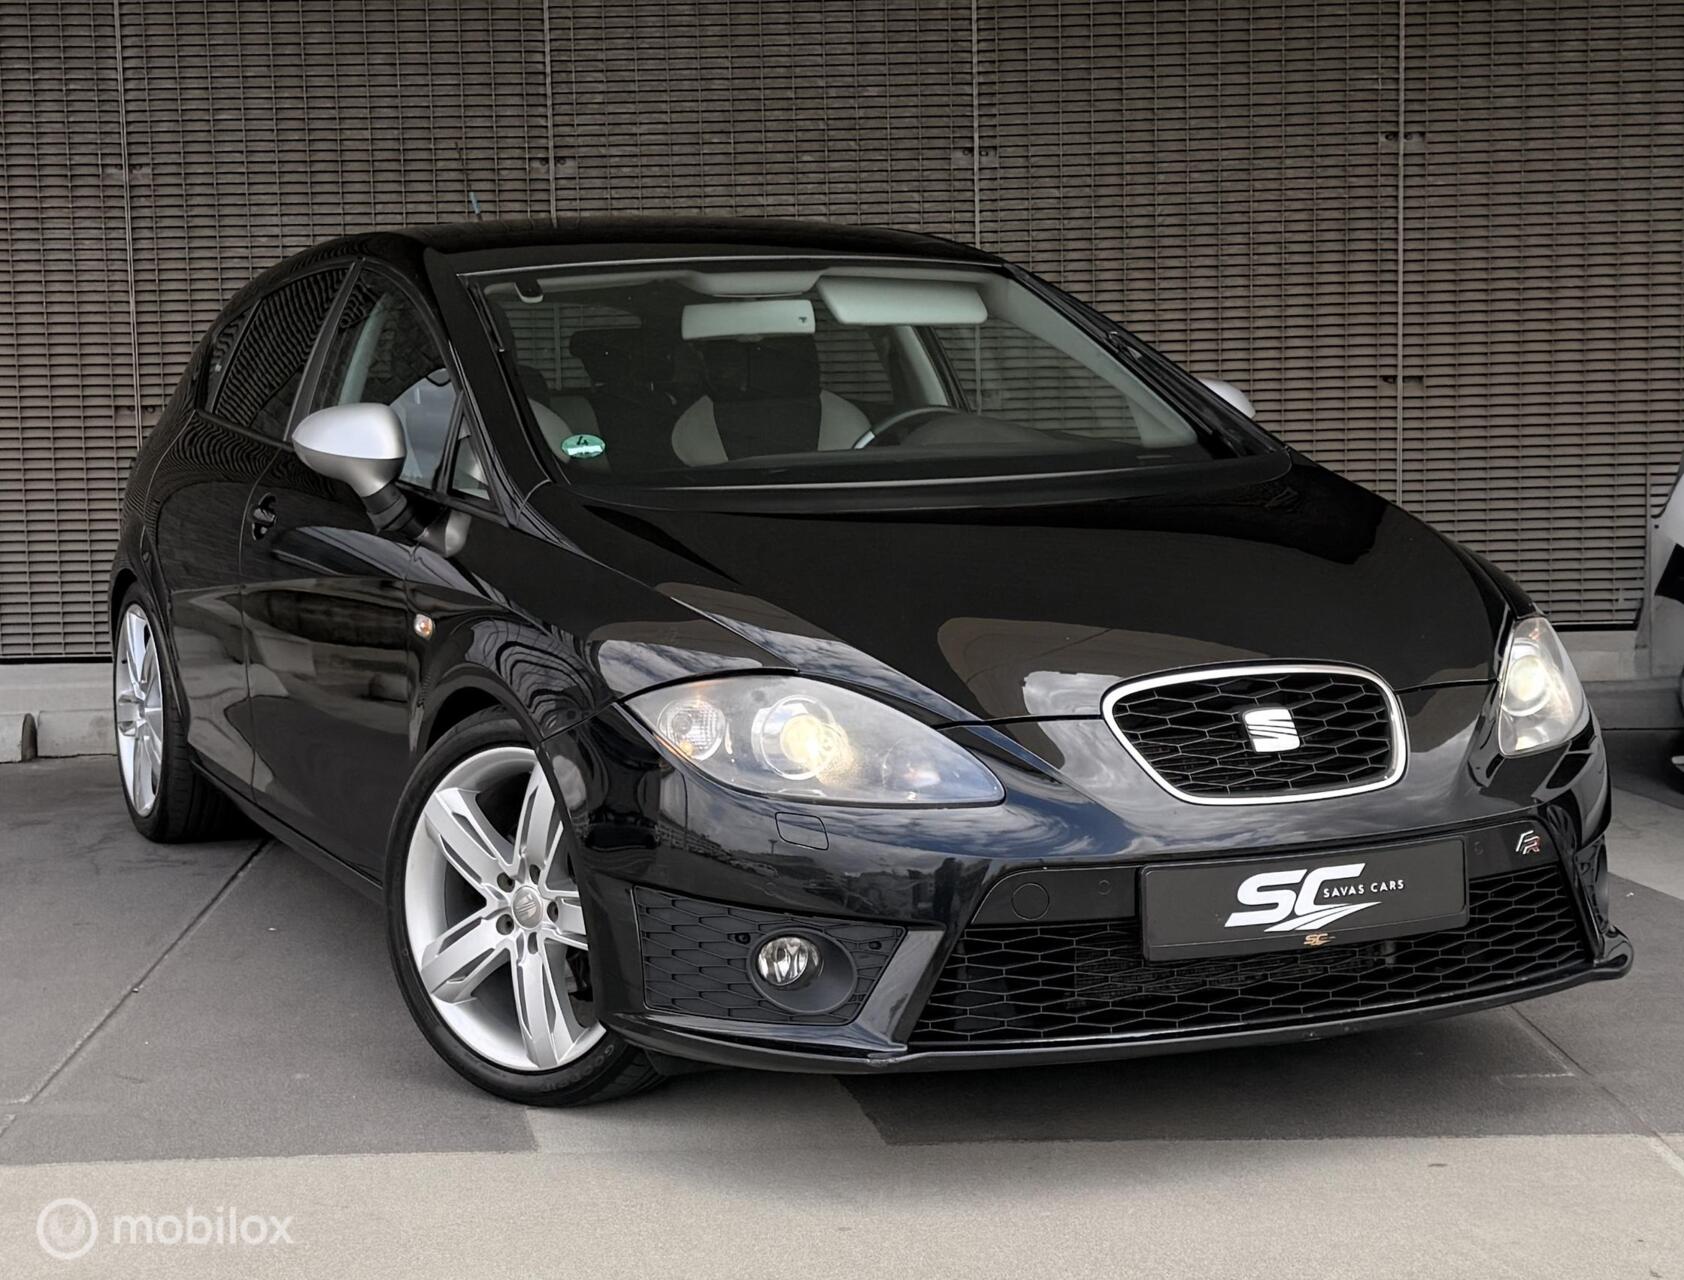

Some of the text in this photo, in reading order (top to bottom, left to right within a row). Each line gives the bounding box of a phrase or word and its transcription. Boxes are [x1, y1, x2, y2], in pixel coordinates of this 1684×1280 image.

[1515, 830, 1540, 854] FR
[1224, 863, 1367, 931] SC
[1323, 880, 1404, 898] SAVAS CARS
